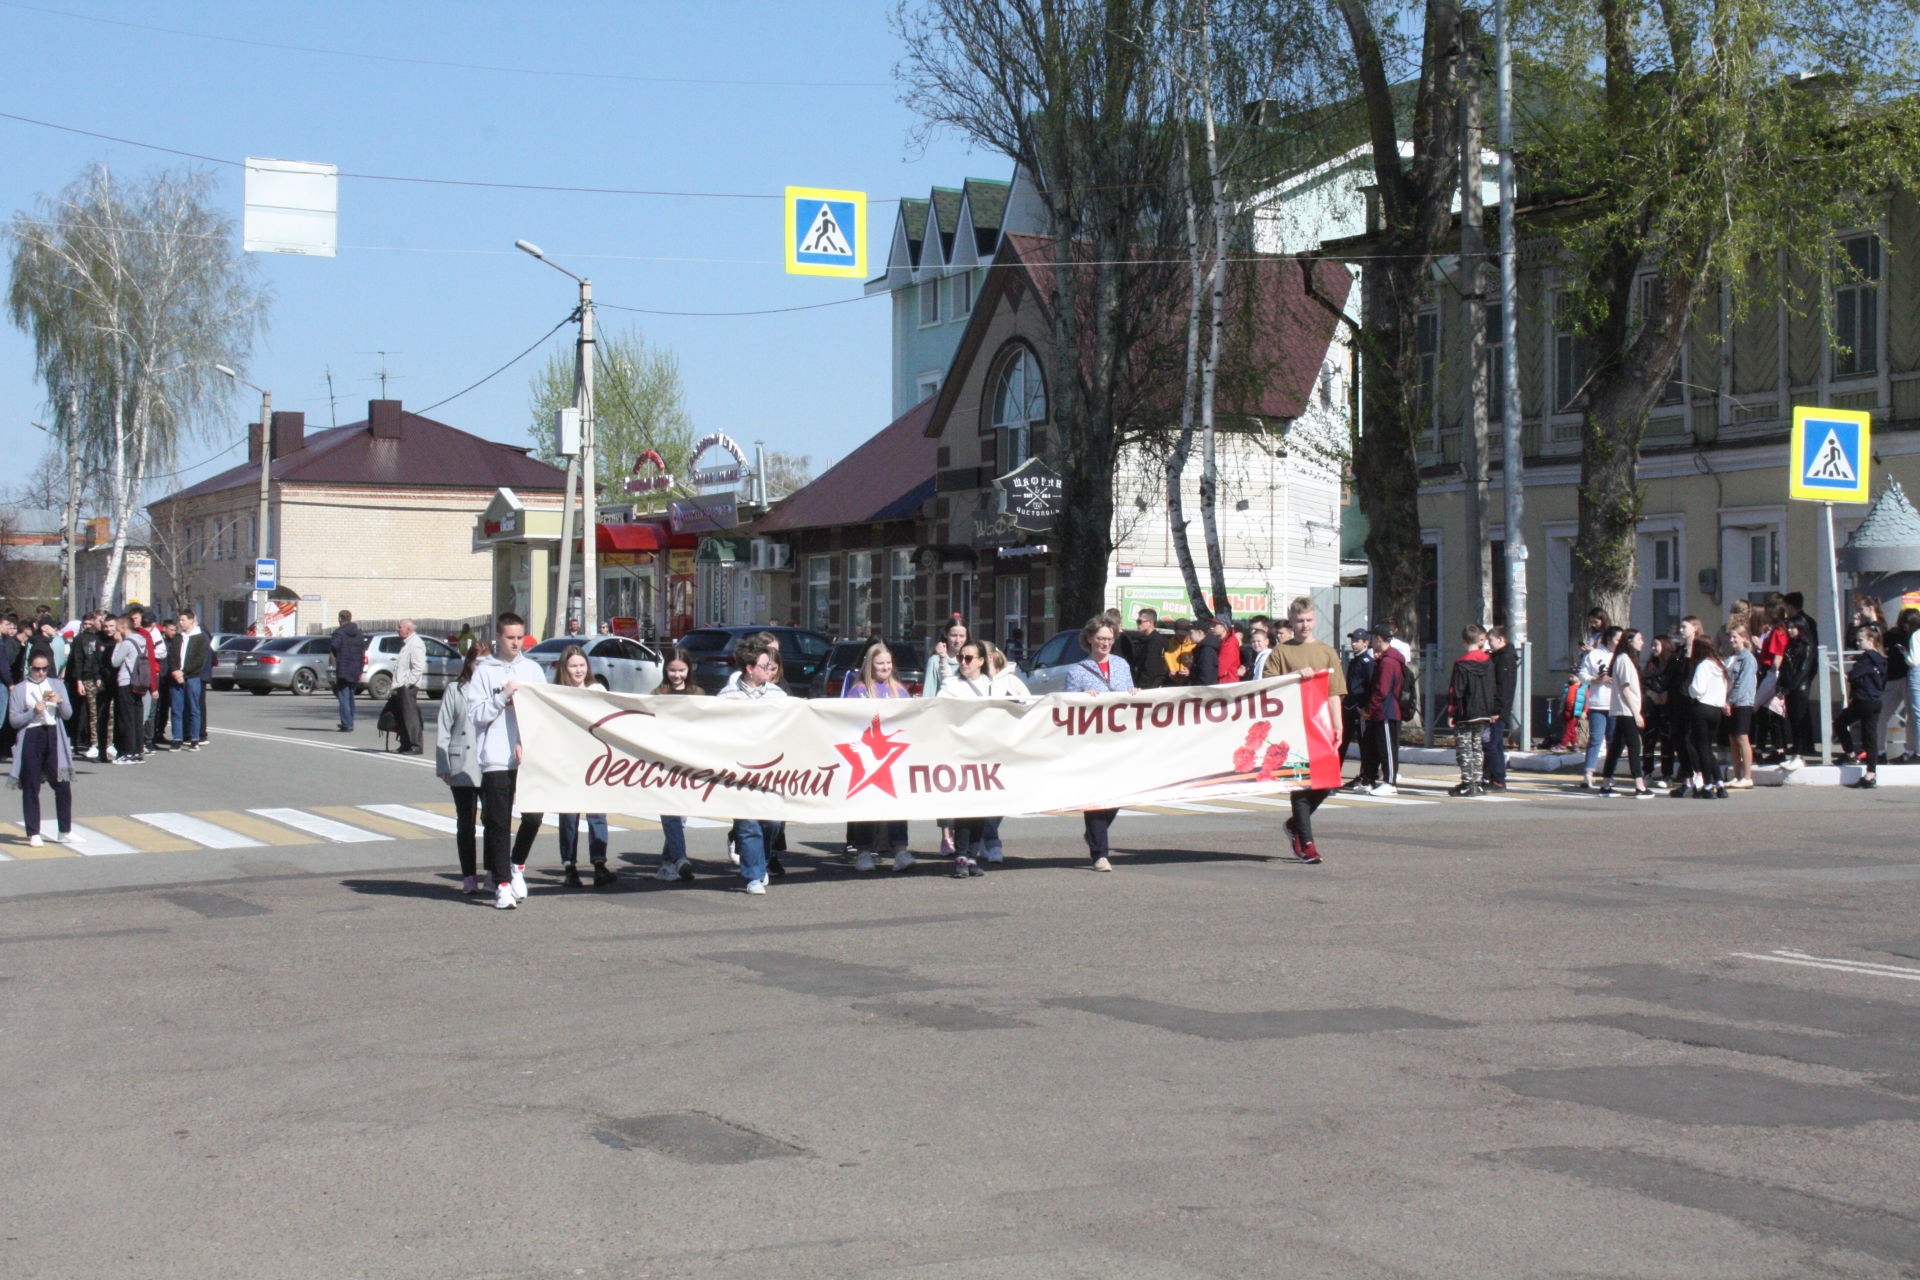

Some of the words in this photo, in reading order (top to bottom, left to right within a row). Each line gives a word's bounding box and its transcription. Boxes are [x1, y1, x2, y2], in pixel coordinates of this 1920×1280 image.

[1052, 688, 1284, 736] ЧИСТОПОЛЬ
[584, 709, 840, 803] бессмертный
[909, 763, 1006, 793] ПОЛК
